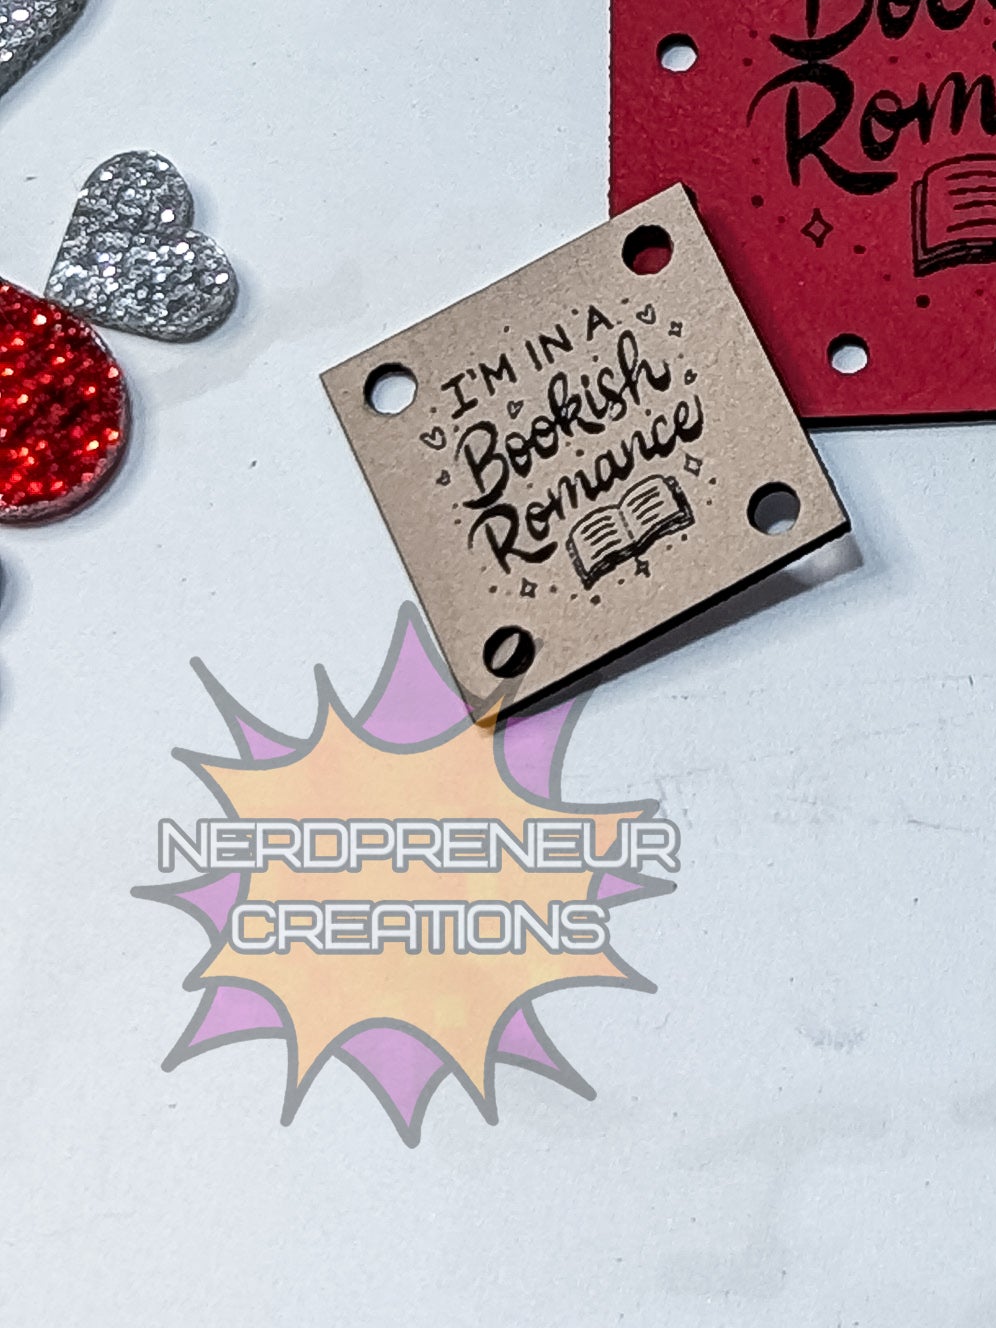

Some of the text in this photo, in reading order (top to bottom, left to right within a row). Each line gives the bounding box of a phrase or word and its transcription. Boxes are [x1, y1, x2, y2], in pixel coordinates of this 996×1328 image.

[441, 305, 614, 420] I'M IN A
[454, 330, 671, 510] Bookish
[467, 394, 704, 574] Romance
